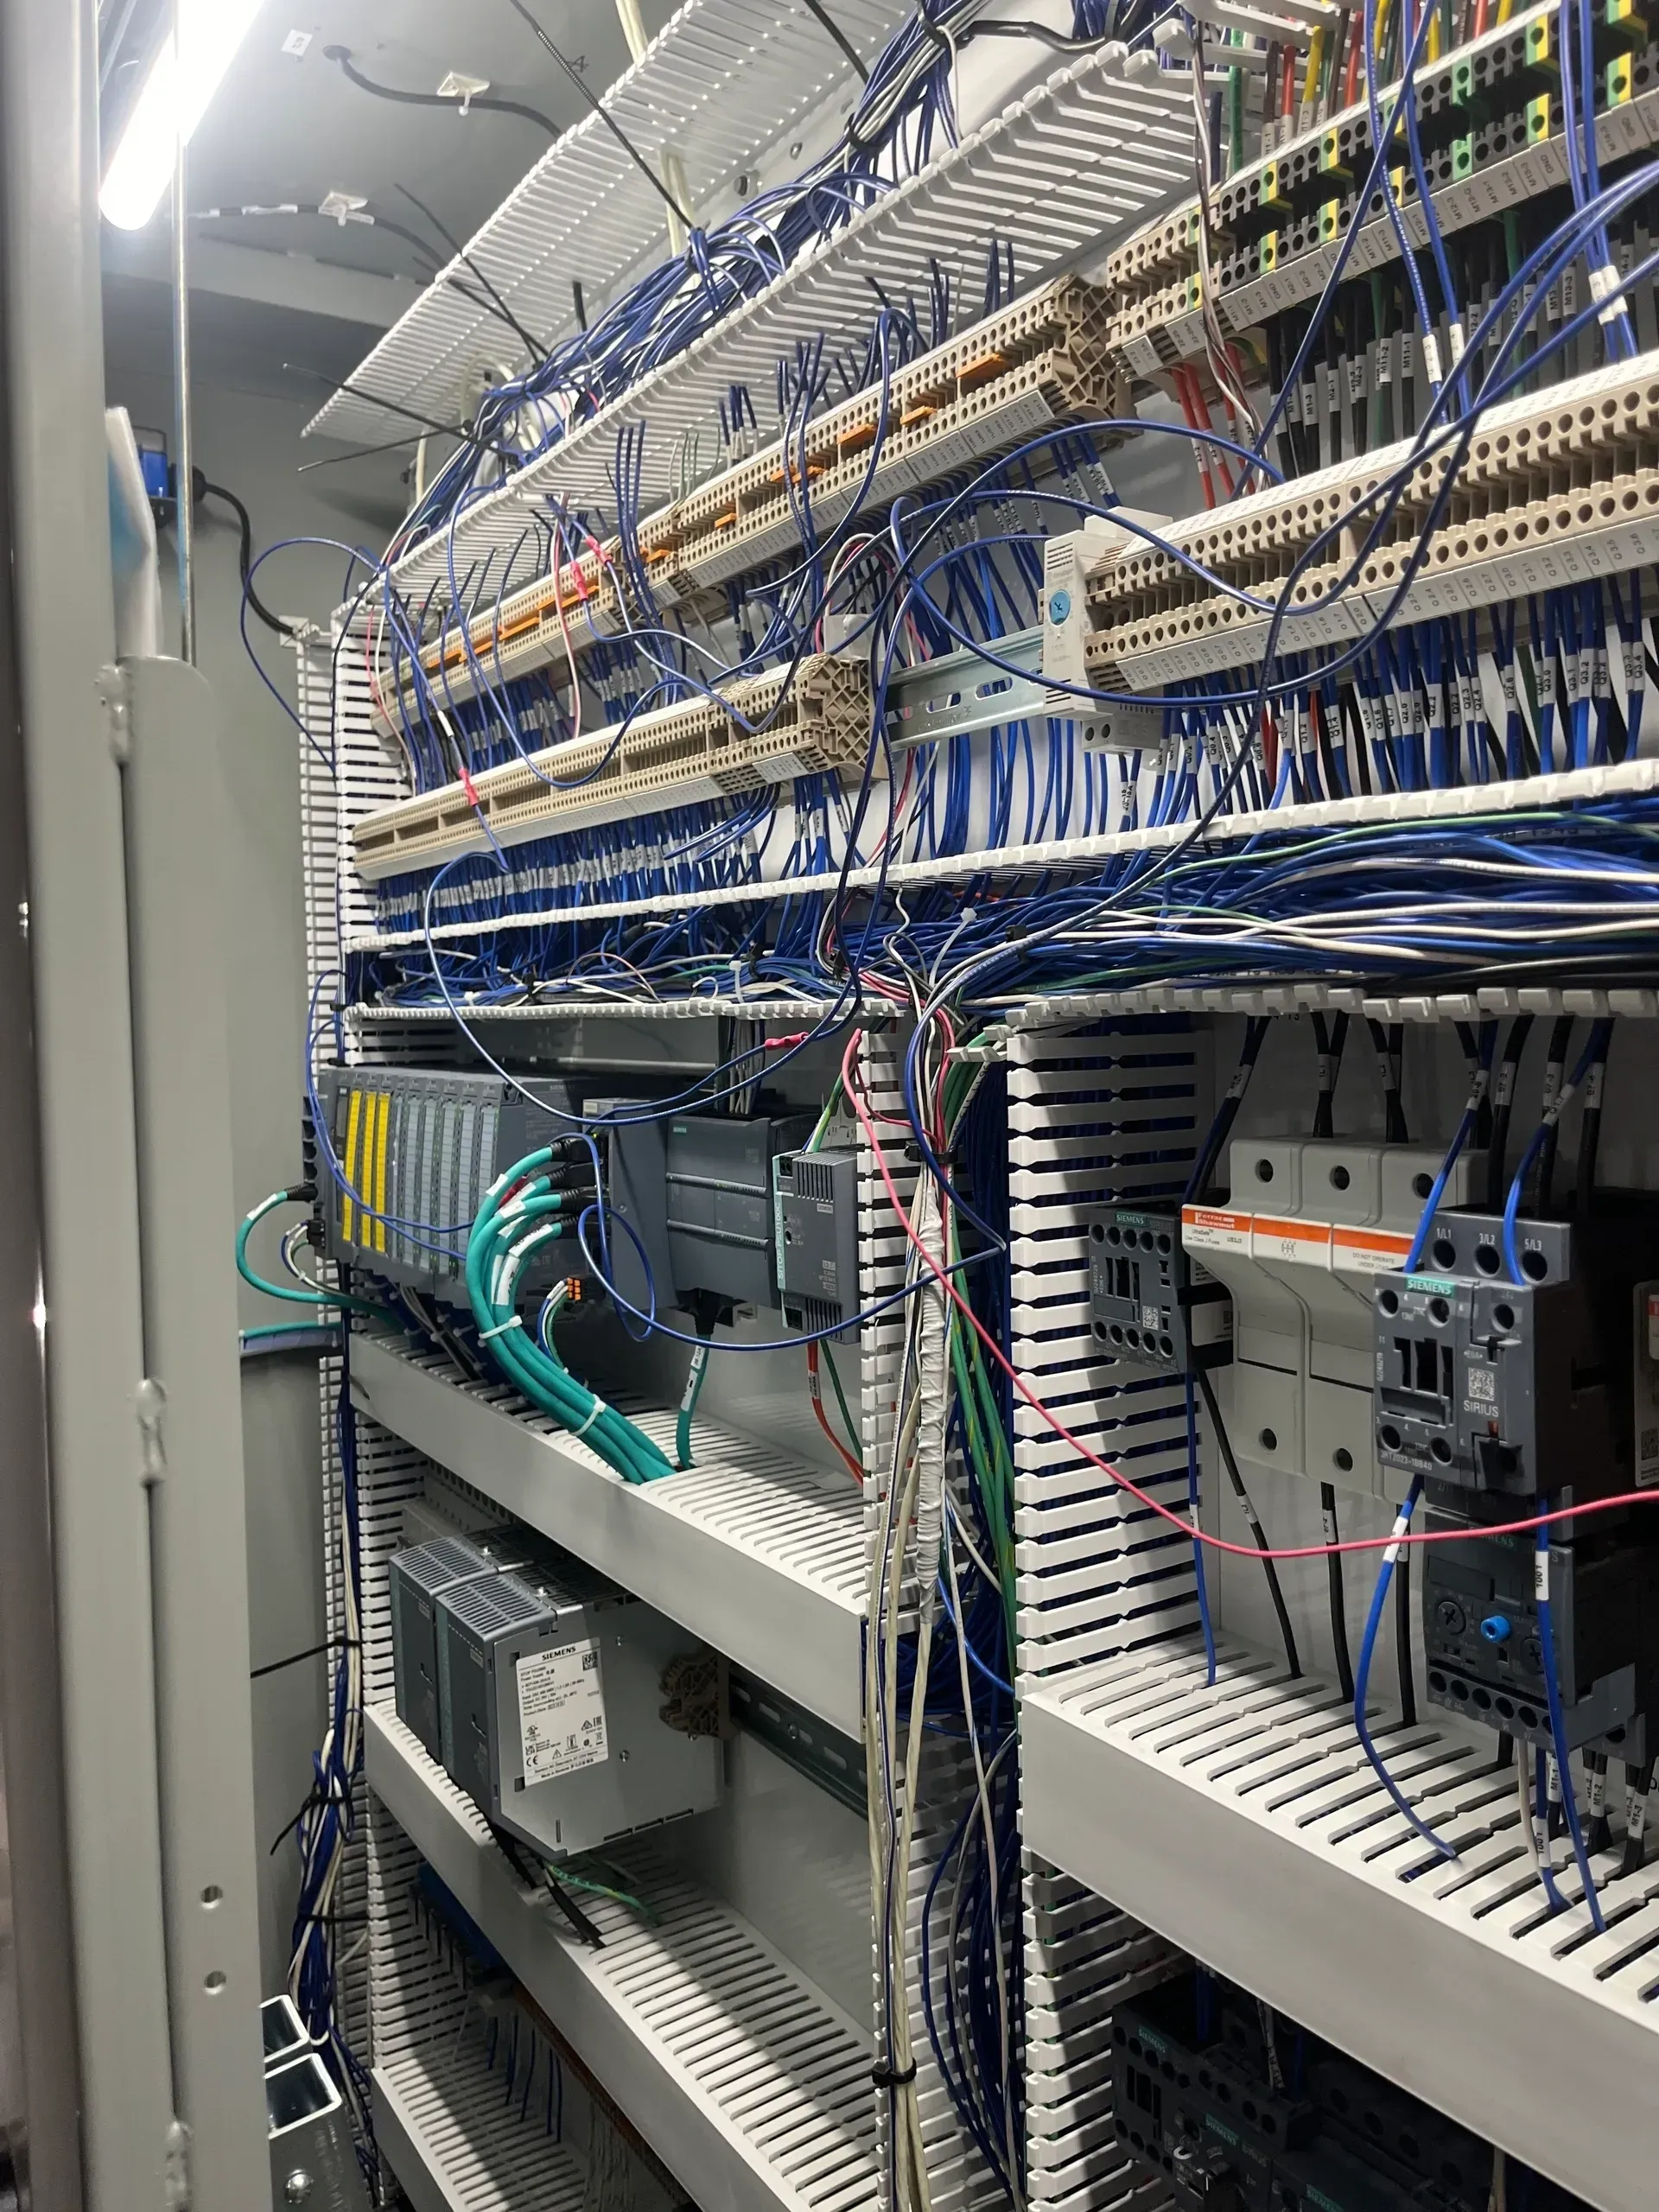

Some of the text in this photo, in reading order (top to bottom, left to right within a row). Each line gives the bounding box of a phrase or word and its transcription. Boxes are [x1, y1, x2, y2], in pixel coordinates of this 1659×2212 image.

[1585, 545, 1601, 566] Q3.4
[1580, 661, 1589, 685] Q3.2
[1116, 1214, 1144, 1225] SIEMENS
[1198, 1212, 1223, 1222] Ferraz
[1198, 1218, 1235, 1229] Shawmut
[1436, 1227, 1452, 1239] 1/L1
[1479, 1233, 1495, 1246] 3/L2
[1524, 1238, 1542, 1251] 5/L3
[1407, 1279, 1453, 1296] SIEMENS
[1463, 1400, 1499, 1417] SIRIUS
[1535, 1565, 1543, 1588] 1001
[542, 1646, 576, 1661] SIEMENS
[1631, 1805, 1643, 1827] M1-3
